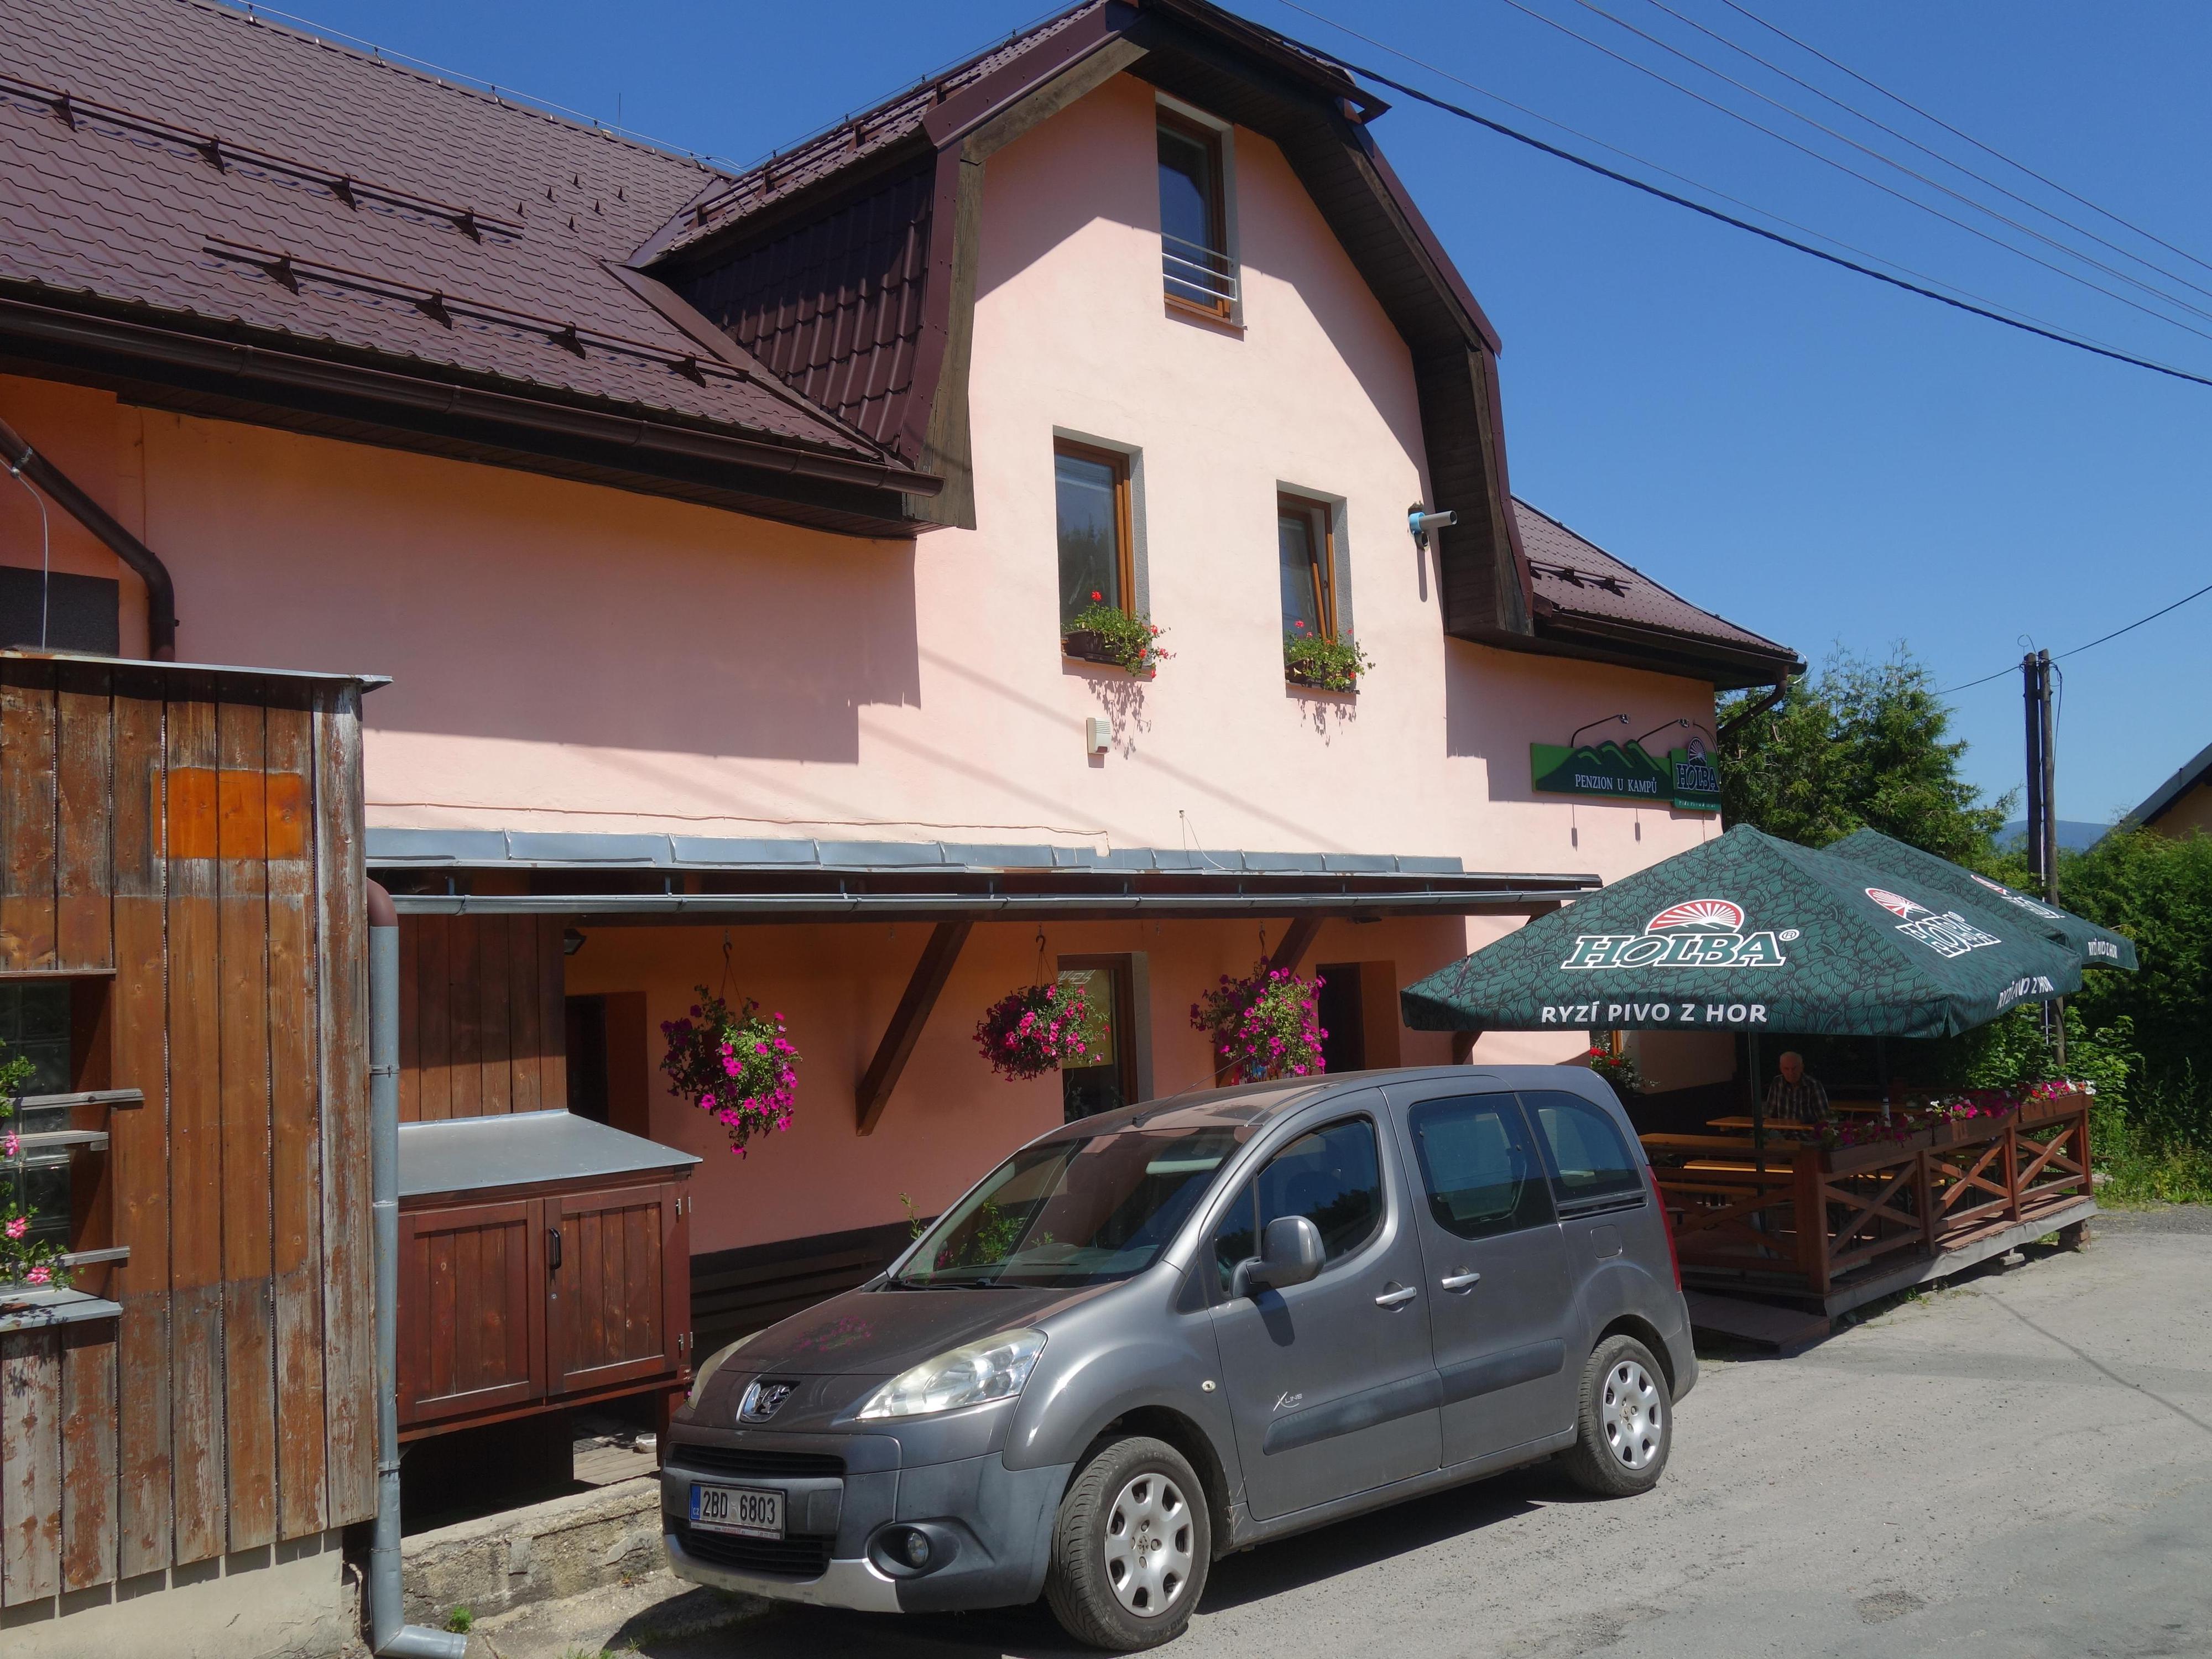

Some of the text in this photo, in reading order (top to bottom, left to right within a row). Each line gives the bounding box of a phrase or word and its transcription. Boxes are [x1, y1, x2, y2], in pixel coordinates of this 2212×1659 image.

[1575, 774, 1657, 794] PENZION U KAMPŮ
[1676, 763, 1720, 792] HOLBA
[1561, 931, 1788, 969] HOLBA
[1541, 1001, 1767, 1023] RYZÍ PIVO Z HOR
[692, 1490, 775, 1525] CZ 2BD 6803
